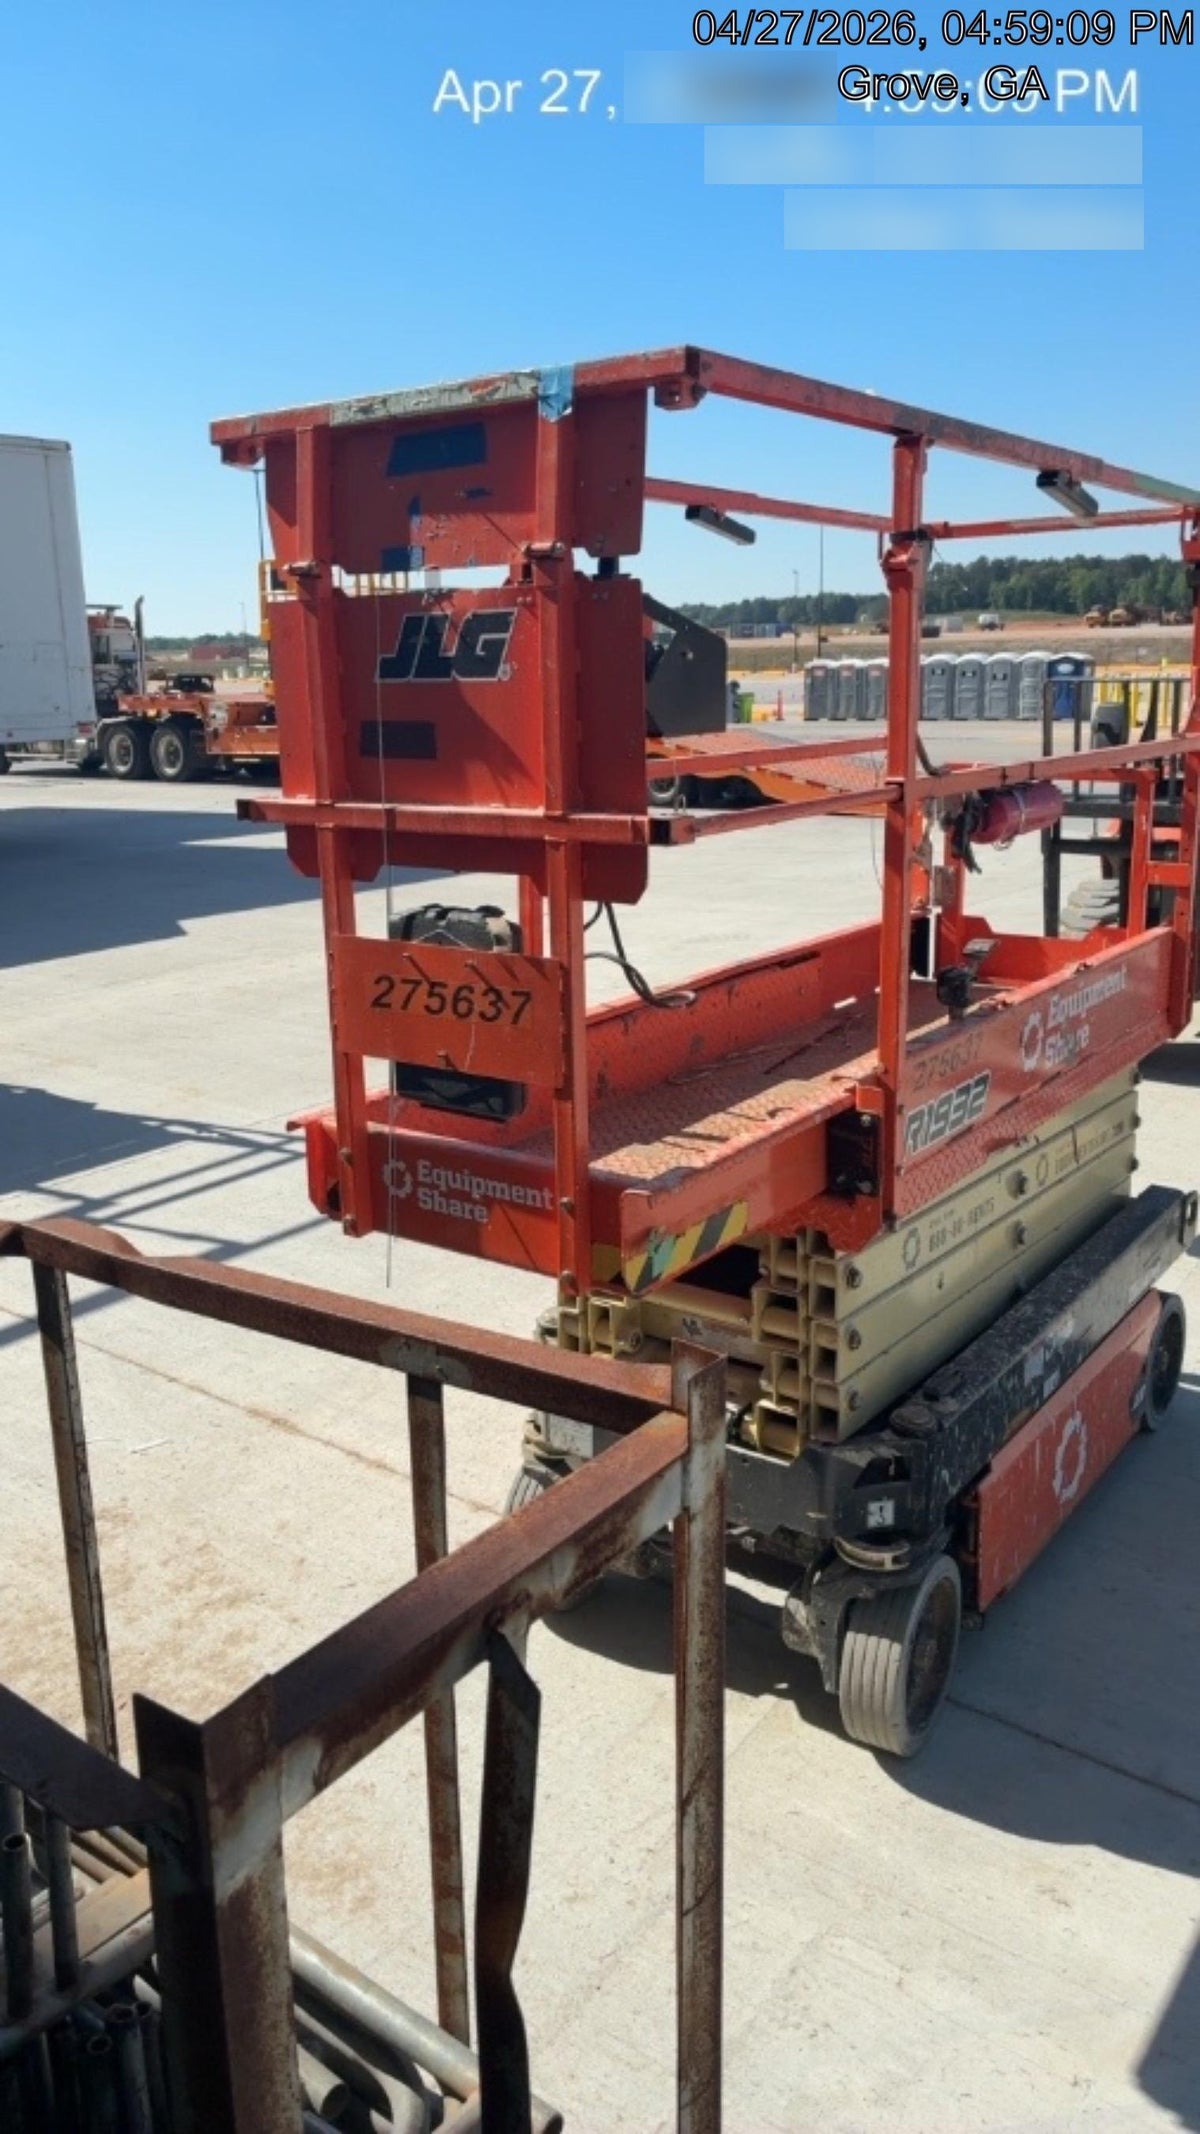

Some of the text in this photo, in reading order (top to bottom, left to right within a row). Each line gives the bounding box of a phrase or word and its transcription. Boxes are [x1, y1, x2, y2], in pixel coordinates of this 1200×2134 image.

[375, 607, 518, 683] JLG
[370, 975, 533, 1025] 275637
[1047, 963, 1127, 1030] Equipment
[416, 1159, 554, 1210] Equipment
[417, 1186, 488, 1223] Share
